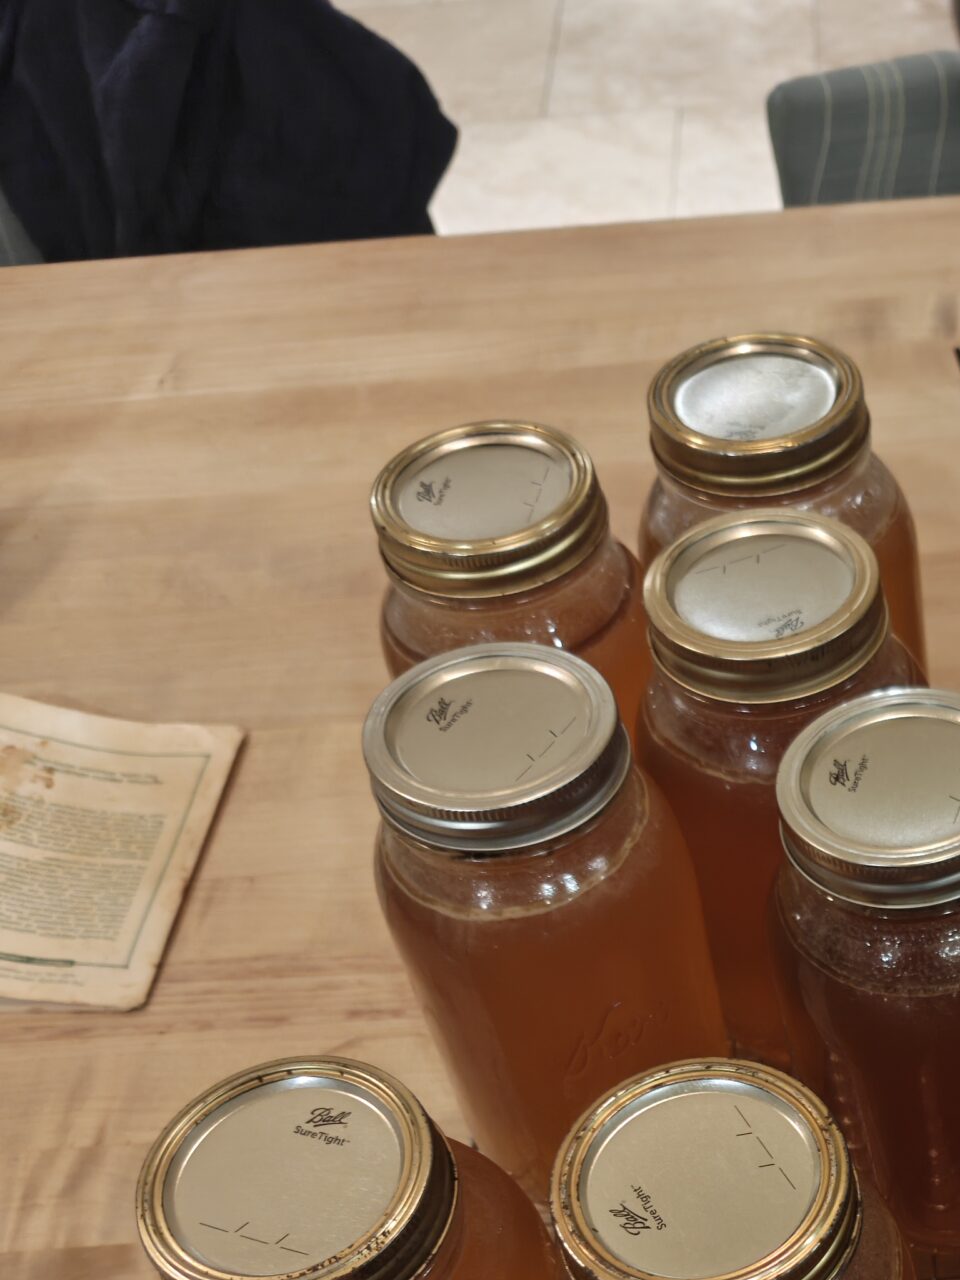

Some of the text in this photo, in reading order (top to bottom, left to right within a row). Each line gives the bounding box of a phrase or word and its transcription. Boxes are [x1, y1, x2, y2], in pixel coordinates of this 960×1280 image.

[426, 697, 455, 725] Ball
[439, 699, 473, 732] SureTight
[829, 758, 851, 787] Ball
[847, 754, 869, 792] SureTight
[305, 1107, 352, 1128] Ball
[293, 1125, 350, 1146] SureTight
[608, 1201, 652, 1236] Ball
[631, 1185, 667, 1231] SureTight
